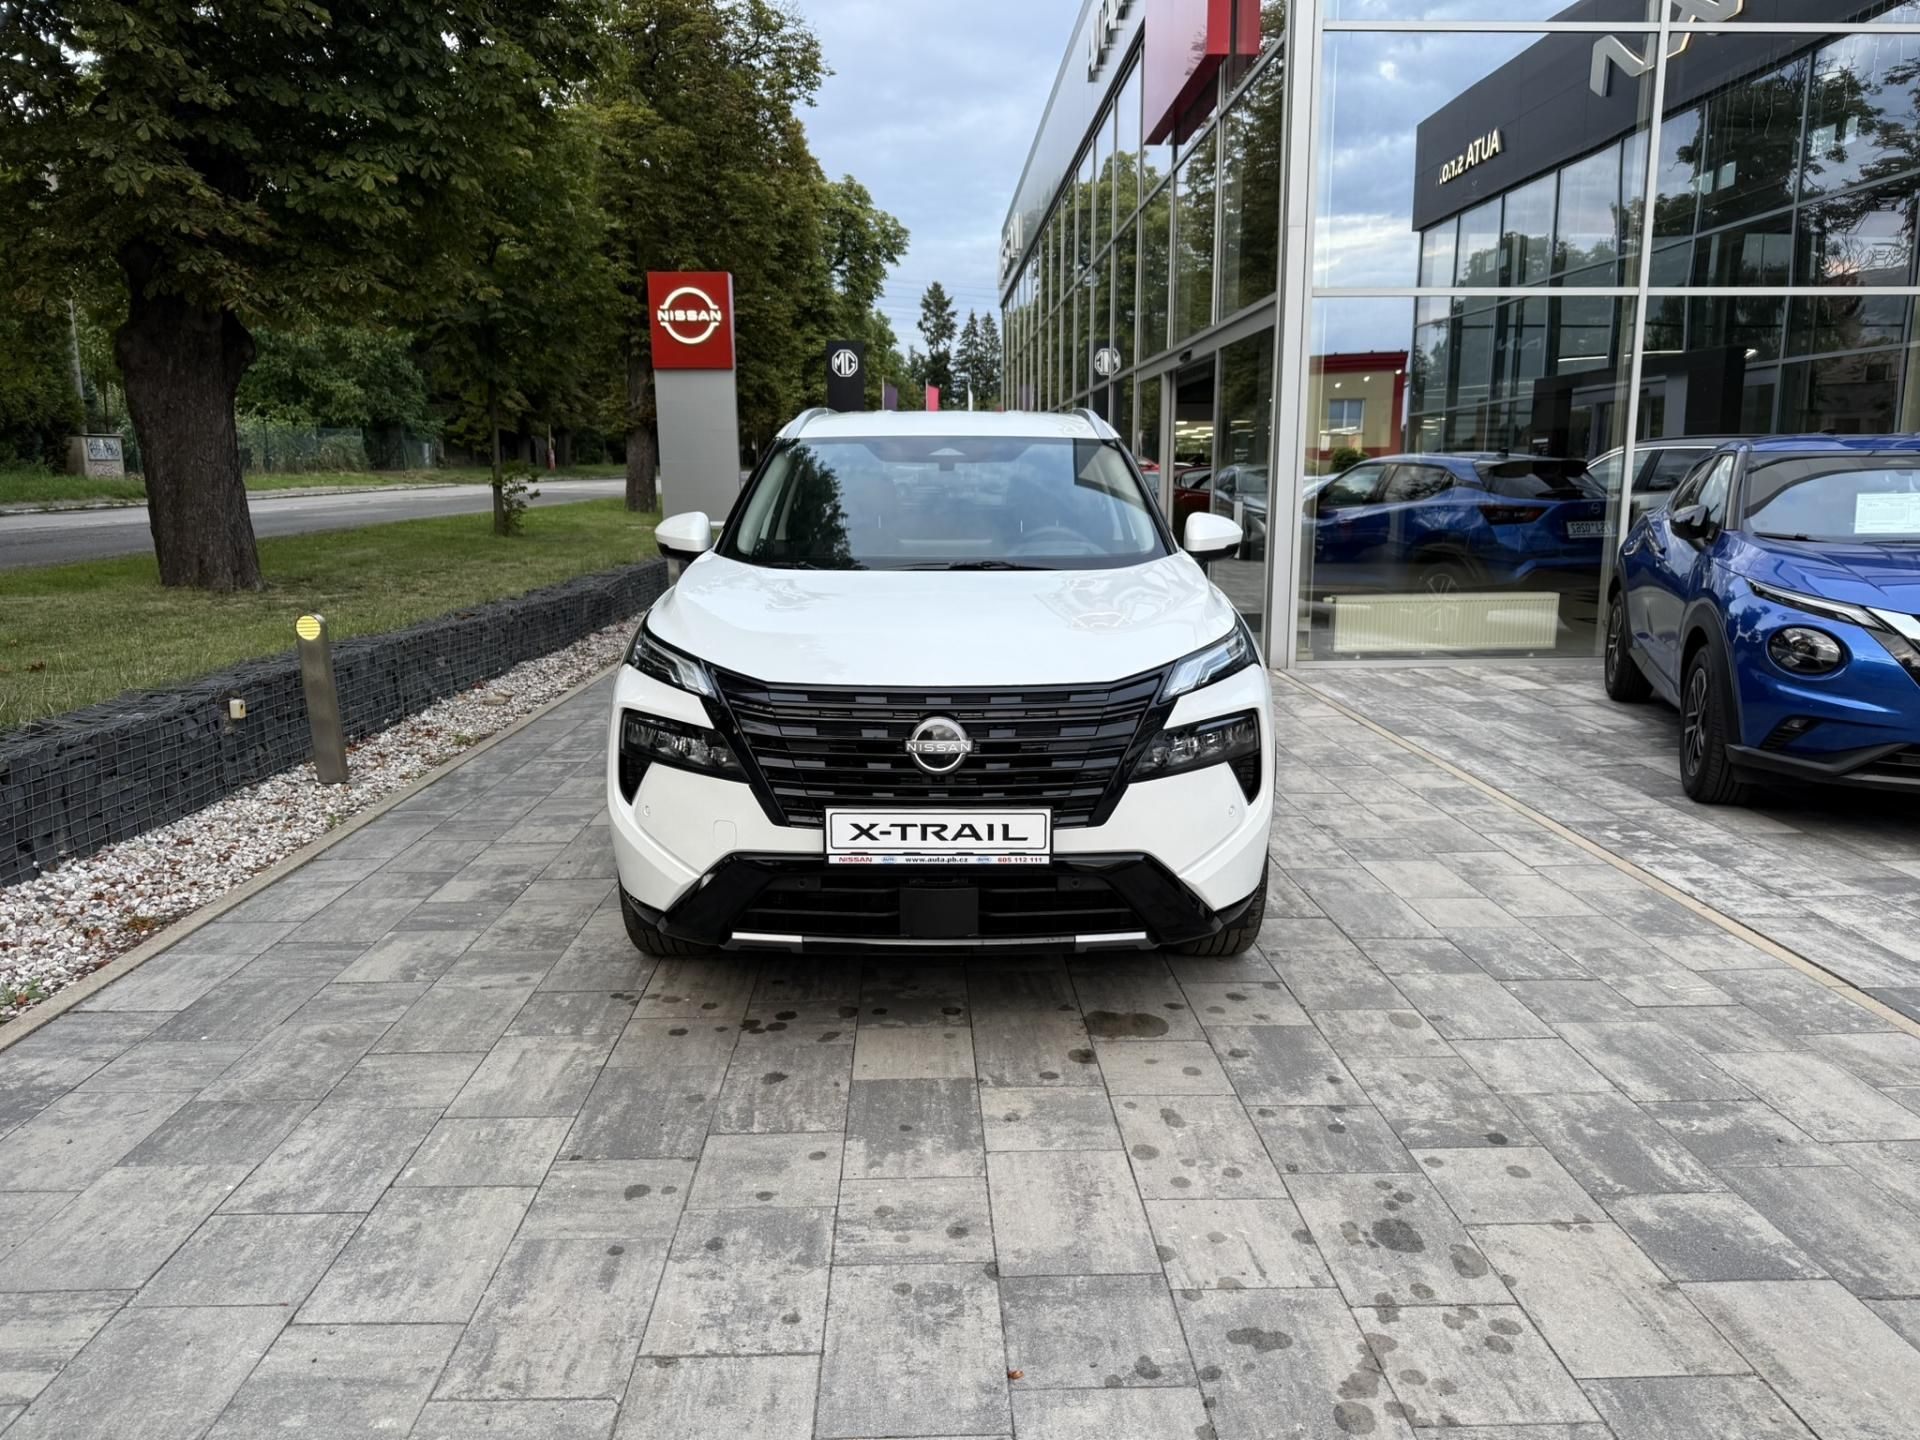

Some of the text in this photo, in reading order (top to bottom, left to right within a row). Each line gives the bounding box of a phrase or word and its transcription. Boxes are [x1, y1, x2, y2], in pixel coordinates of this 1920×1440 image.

[657, 309, 722, 321] NISSAN
[833, 351, 857, 375] MG
[906, 743, 970, 752] NISSAN
[849, 823, 1029, 841] X-TRAIL
[905, 856, 968, 864] www.auta.pb.cz
